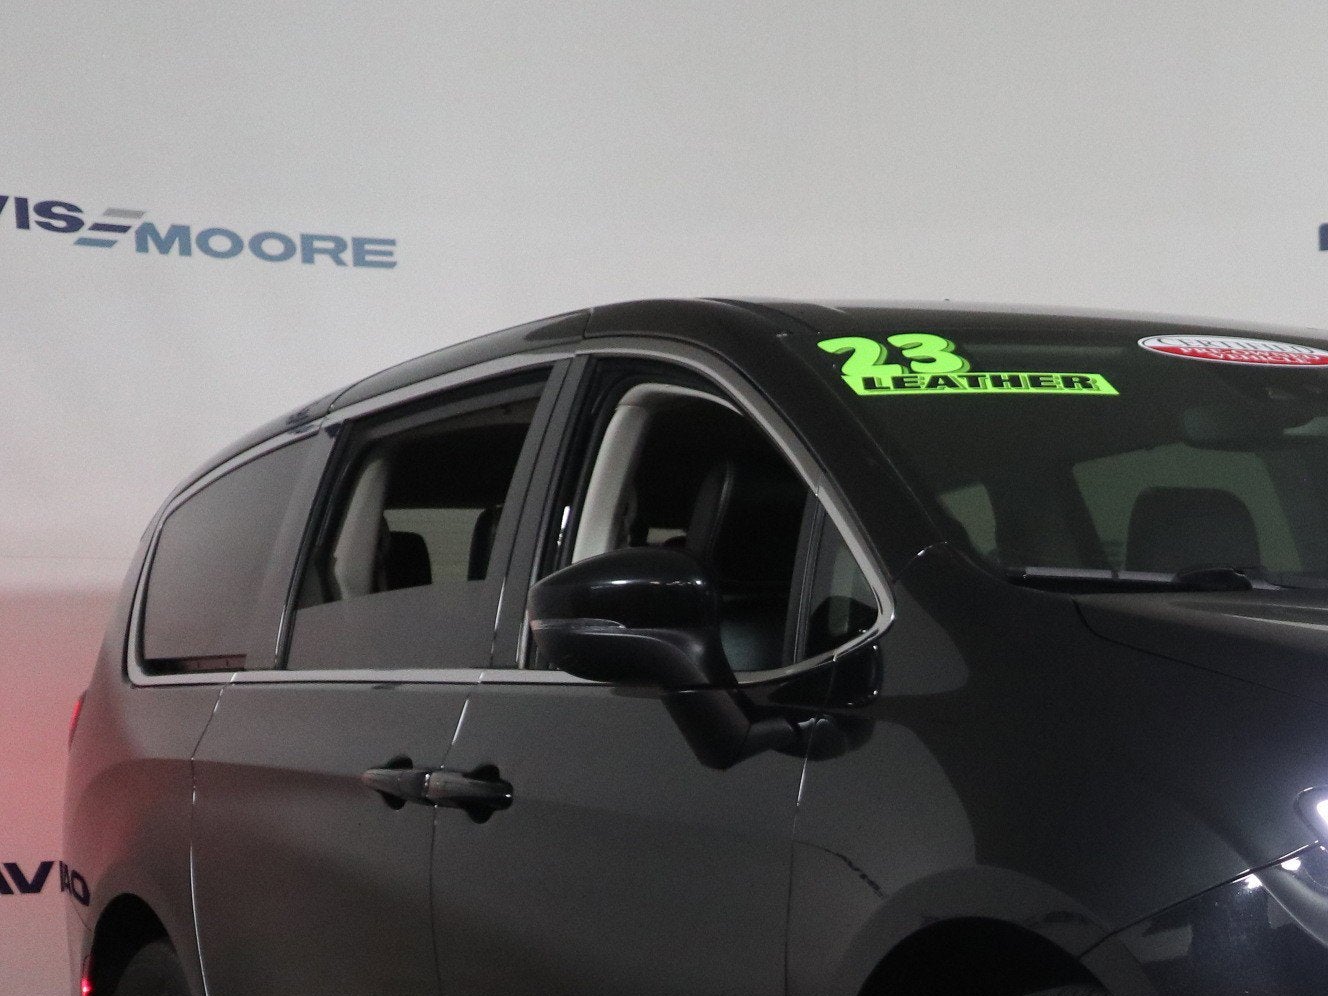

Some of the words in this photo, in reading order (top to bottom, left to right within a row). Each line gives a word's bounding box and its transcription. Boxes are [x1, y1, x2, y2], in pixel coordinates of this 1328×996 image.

[0, 195, 85, 234] IS
[134, 222, 398, 270] MOORE
[817, 333, 971, 376] 23
[861, 374, 1100, 391] LEATHER
